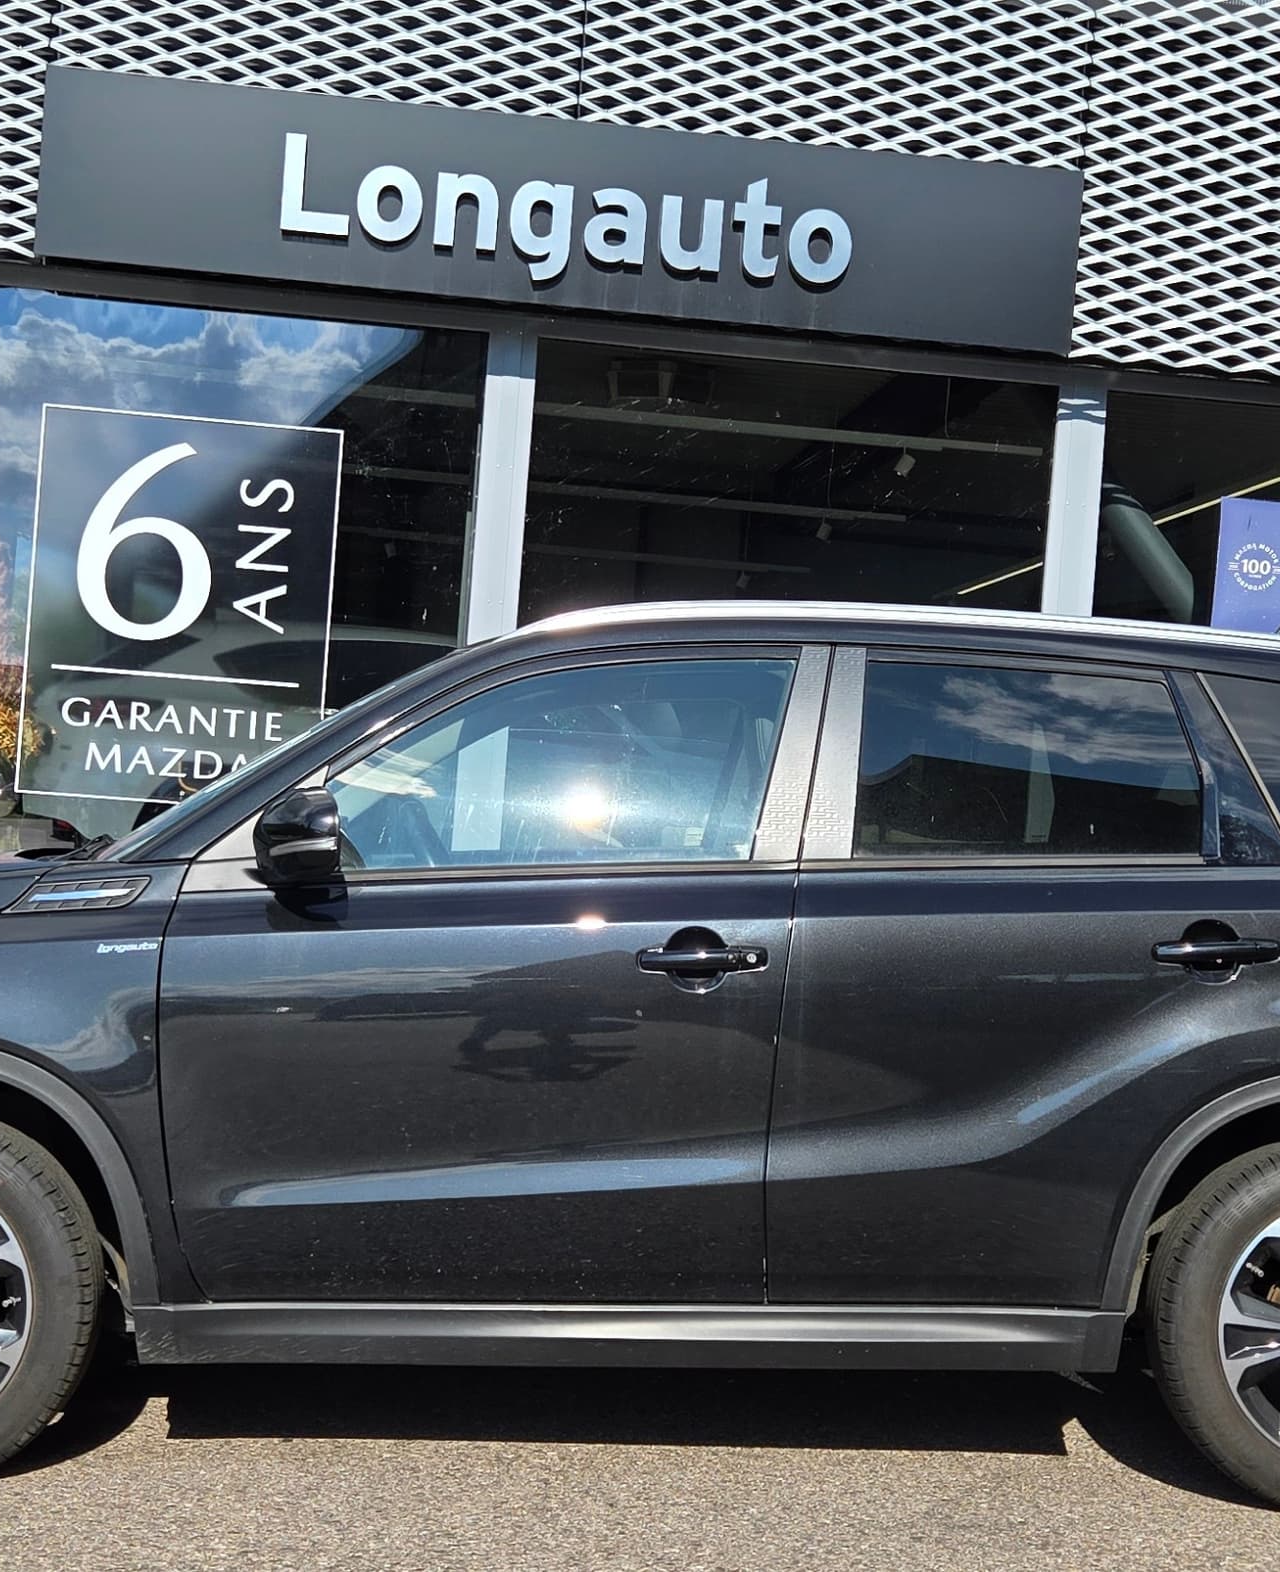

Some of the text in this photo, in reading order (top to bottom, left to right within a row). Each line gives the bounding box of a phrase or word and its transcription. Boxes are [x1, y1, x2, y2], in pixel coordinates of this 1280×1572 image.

[279, 132, 853, 281] Longauto
[76, 442, 295, 641] 6 ANS
[1240, 558, 1271, 575] 100
[61, 697, 283, 743] GARANTIE
